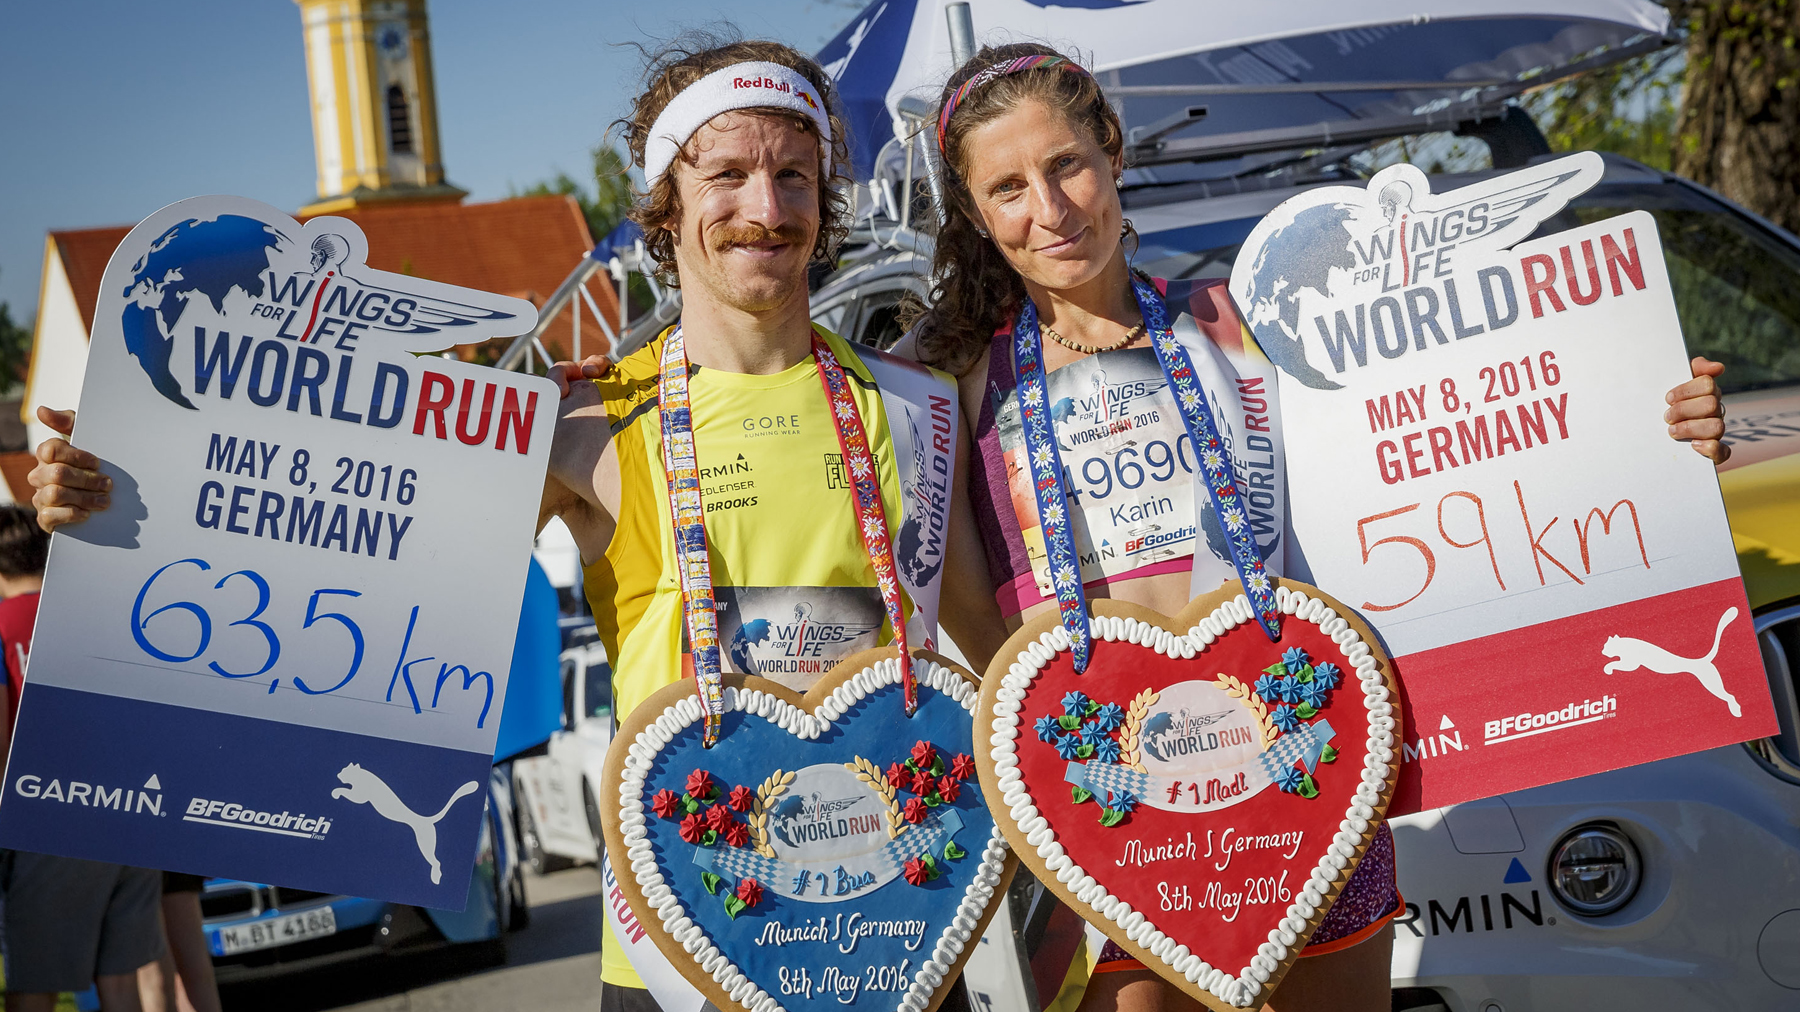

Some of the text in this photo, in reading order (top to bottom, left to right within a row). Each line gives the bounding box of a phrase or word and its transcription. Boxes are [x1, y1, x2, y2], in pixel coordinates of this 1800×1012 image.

[734, 77, 790, 93] Red Bull
[1353, 267, 1380, 286] FOR
[250, 303, 284, 322] FOR
[1365, 350, 1561, 434] MAY 8, 2016
[743, 415, 800, 431] GORE
[744, 430, 779, 438] RUNNING
[1079, 412, 1094, 421] FOR
[1134, 411, 1160, 428] 2016
[1376, 392, 1570, 485] GERMANY
[205, 433, 418, 506] MAY 8, 2016
[195, 480, 414, 561] GERMANY
[706, 496, 758, 512] BROOKS
[1110, 496, 1173, 527] Karin
[1080, 547, 1116, 567] MIN
[385, 604, 495, 729] km
[1402, 695, 1617, 763] MIN BFGoodrich
[15, 775, 332, 835] GARMIN BFGoodrich
[1115, 832, 1197, 867] Munich
[1215, 827, 1304, 872] Germany
[1157, 869, 1291, 923] 8th May 2016
[1394, 890, 1544, 940] RMIN
[755, 917, 828, 946] Munich
[839, 912, 926, 954] Germany
[779, 958, 909, 1004] 8th May 2016
